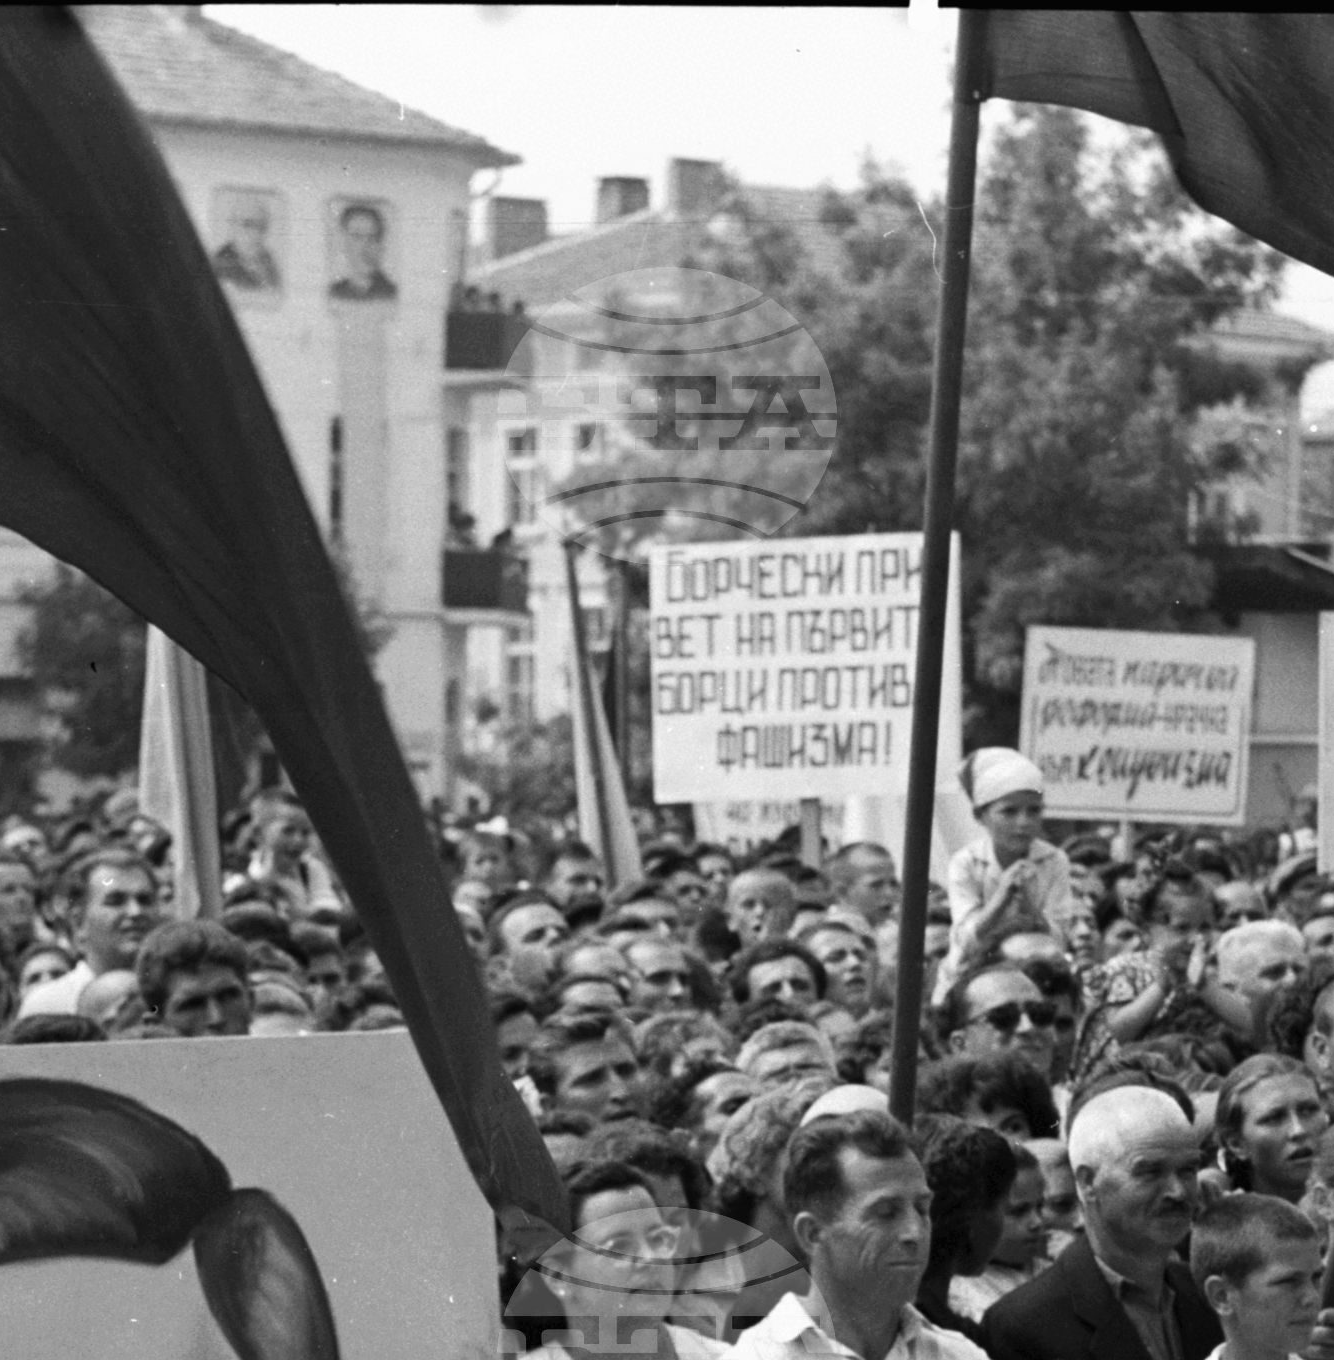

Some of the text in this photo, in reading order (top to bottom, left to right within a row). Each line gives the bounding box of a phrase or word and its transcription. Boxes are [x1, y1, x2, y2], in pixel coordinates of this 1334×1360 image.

[656, 605, 920, 659] ВЕТ НА ПЪРВИТ
[656, 664, 911, 715] БОРЦИ ПРОТИВ
